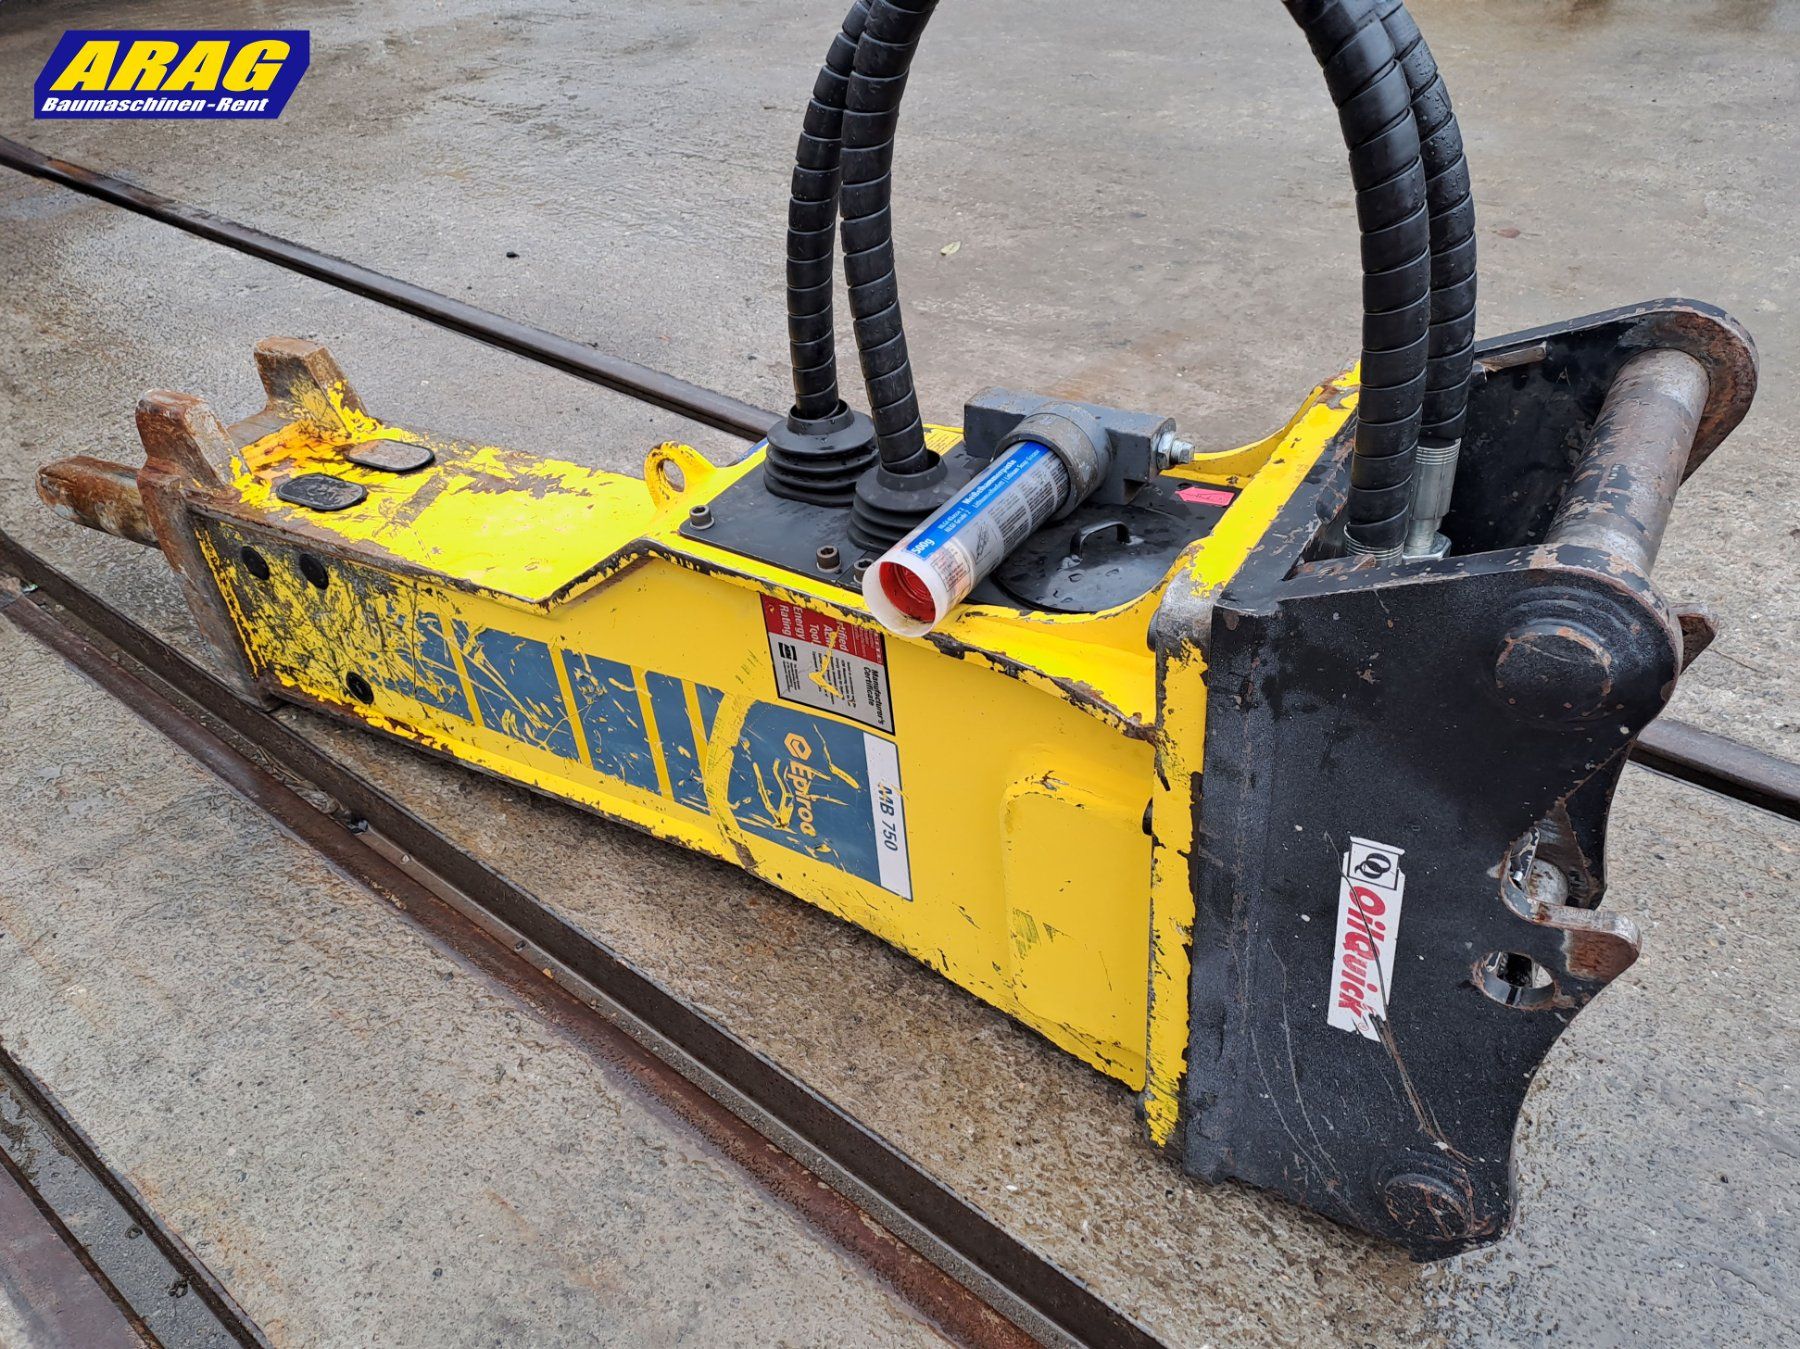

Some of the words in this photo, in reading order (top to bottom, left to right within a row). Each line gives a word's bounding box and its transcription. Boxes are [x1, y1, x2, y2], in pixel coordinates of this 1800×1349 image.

[911, 538, 935, 555] 500g
[779, 604, 791, 636] Rating
[793, 606, 806, 640] Energy
[810, 624, 821, 643] Tool
[863, 666, 874, 706] Certificate
[872, 669, 885, 725] Manufacturer's
[877, 784, 894, 814] MB
[880, 819, 897, 851] 750
[1337, 885, 1386, 1018] OilQuick
